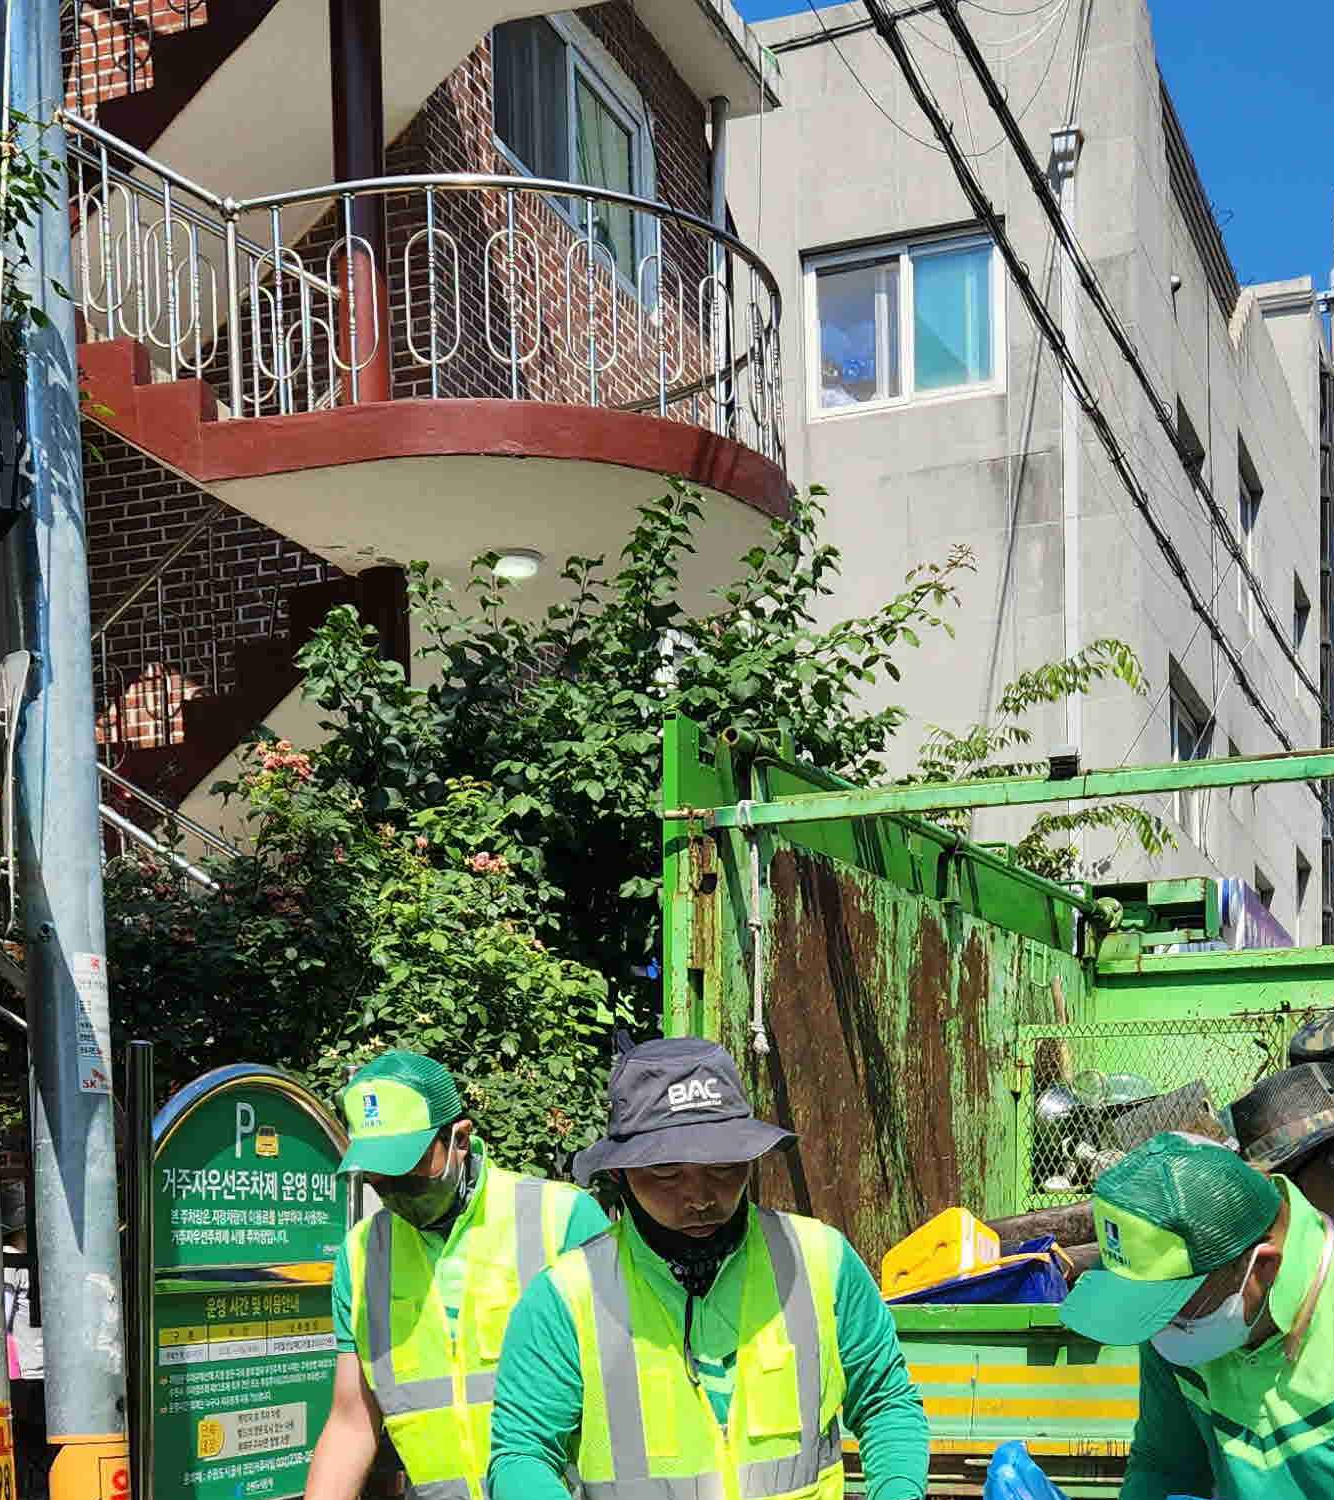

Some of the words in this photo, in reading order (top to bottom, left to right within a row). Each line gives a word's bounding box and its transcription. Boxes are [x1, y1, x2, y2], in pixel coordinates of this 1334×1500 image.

[668, 1078, 722, 1105] BAC
[163, 1167, 278, 1202] 거주자우선주차제
[281, 1170, 308, 1202] 운영
[311, 1172, 338, 1203] 안내
